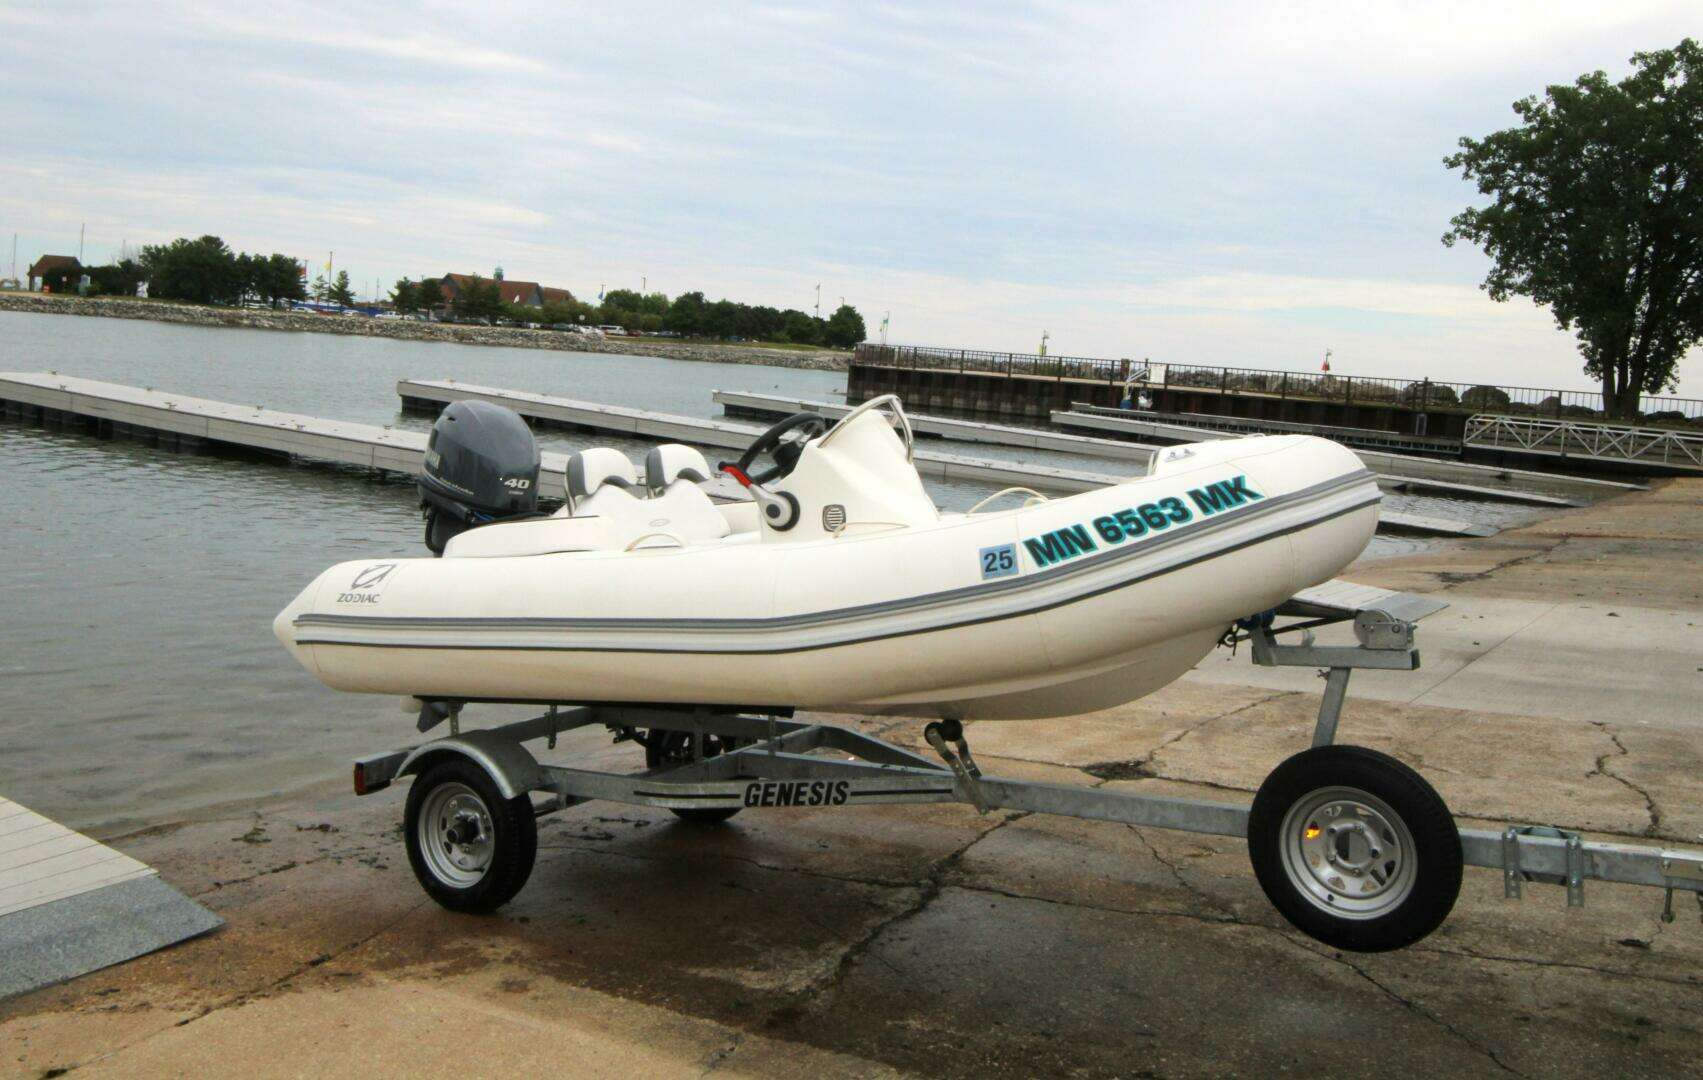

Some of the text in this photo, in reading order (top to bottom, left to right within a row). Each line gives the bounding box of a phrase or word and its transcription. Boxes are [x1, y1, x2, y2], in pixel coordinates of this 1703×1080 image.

[504, 479, 530, 489] 40
[1023, 475, 1265, 567] MN 6563 MK
[984, 549, 1013, 573] 25
[336, 592, 380, 604] ZODIAC
[744, 780, 849, 807] GENESIS
